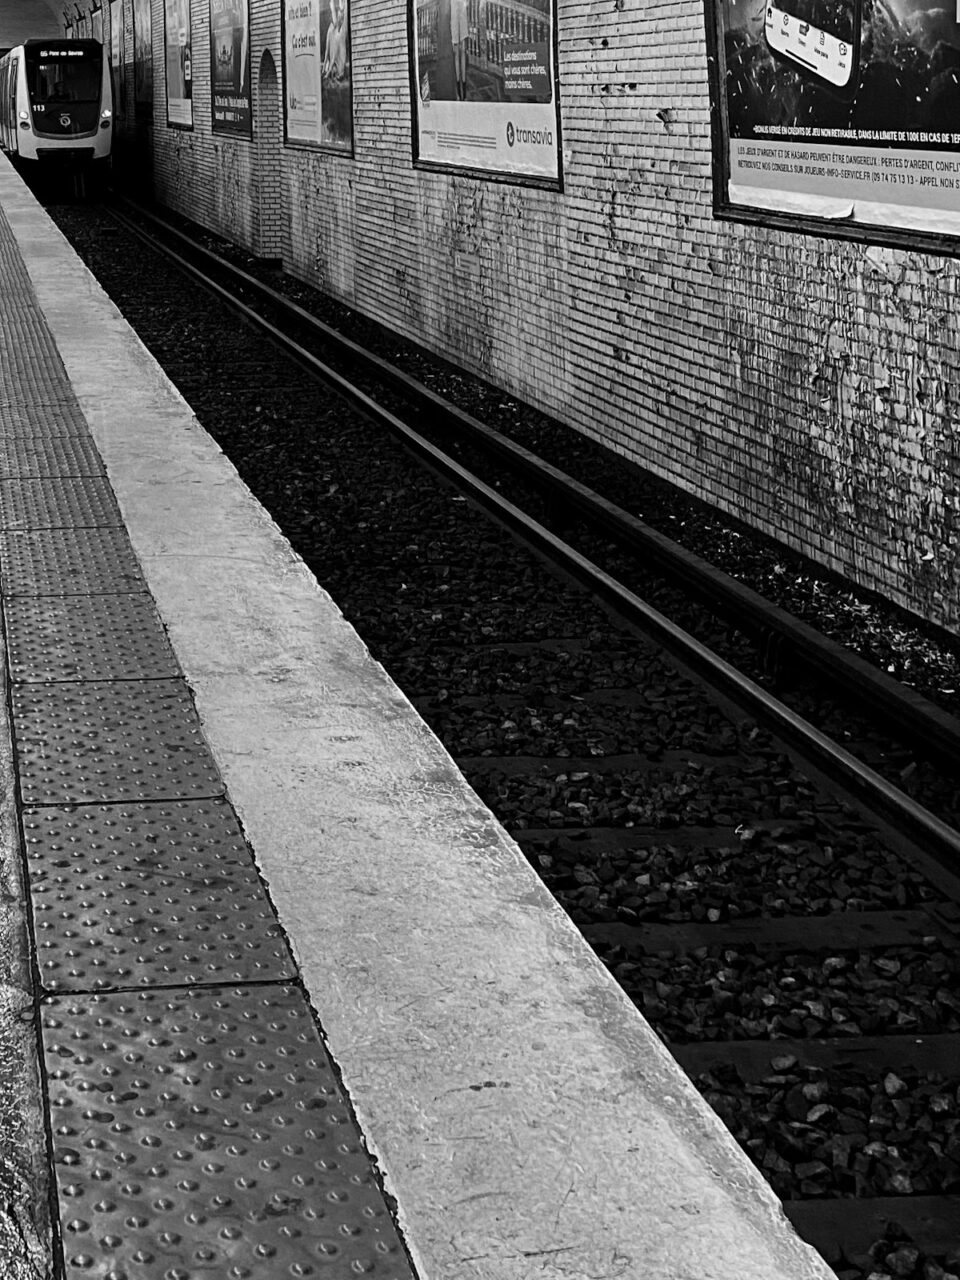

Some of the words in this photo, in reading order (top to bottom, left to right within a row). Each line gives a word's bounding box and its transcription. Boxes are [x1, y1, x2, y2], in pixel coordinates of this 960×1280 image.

[516, 126, 553, 146] transavia
[812, 127, 820, 136] JEU
[821, 128, 831, 137] NON
[858, 129, 871, 139] DANS
[898, 131, 906, 141] DE
[920, 132, 928, 142] EN
[929, 132, 940, 143] CAS
[941, 133, 950, 143] DE
[757, 148, 777, 158] D'ARGENT
[784, 150, 790, 159] DE
[791, 151, 809, 161] HASARD
[810, 151, 832, 162] PEUVENT
[832, 152, 845, 163] ÊTRE
[845, 155, 877, 166] DANGEREUX
[881, 157, 903, 169] PERTES
[904, 158, 935, 172] D'ARGENT,
[738, 159, 761, 170] RETROUVEZ
[762, 161, 771, 171] NOS
[771, 162, 793, 173] CONSEILS
[794, 164, 803, 174] SUR
[881, 173, 888, 182] 74
[898, 174, 905, 184] 13
[907, 175, 914, 185] 13
[919, 176, 938, 187] APPEL
[940, 178, 954, 189] NON
